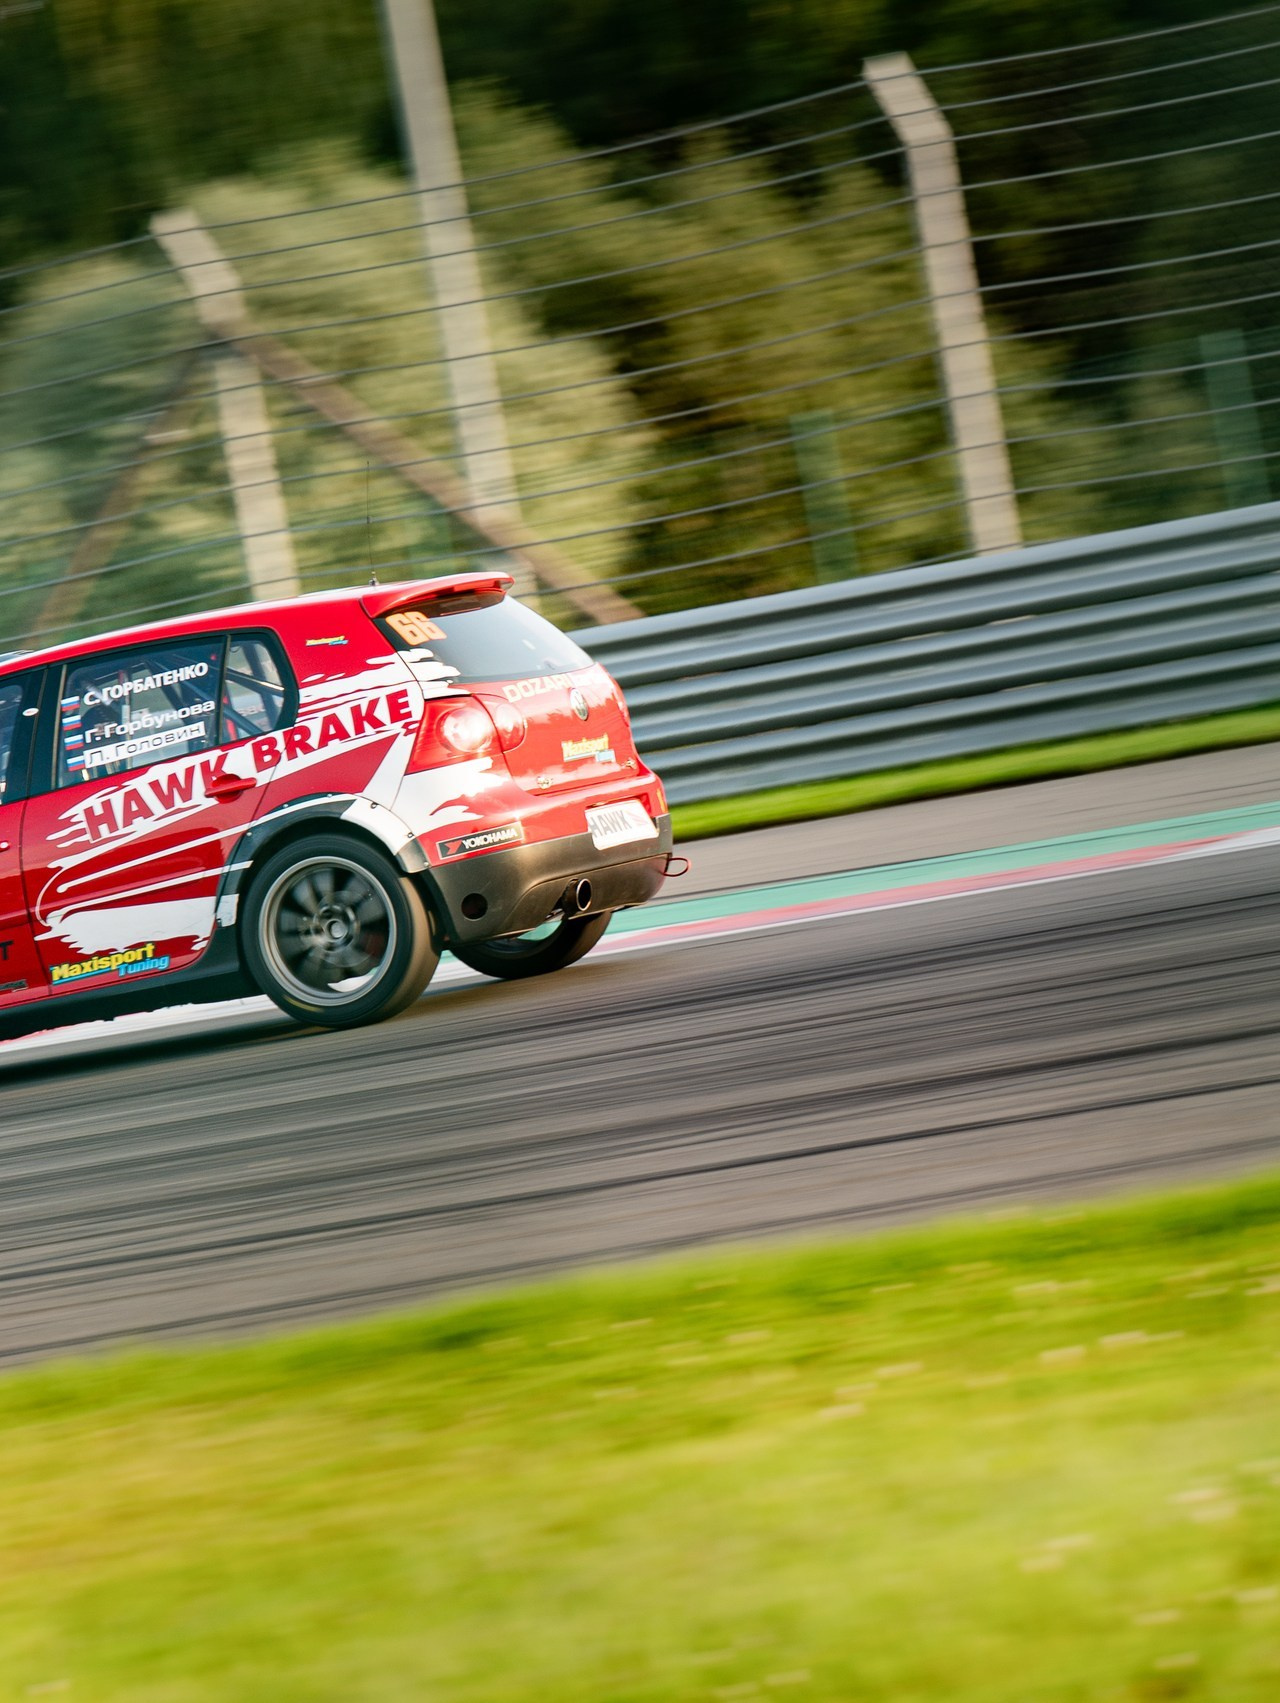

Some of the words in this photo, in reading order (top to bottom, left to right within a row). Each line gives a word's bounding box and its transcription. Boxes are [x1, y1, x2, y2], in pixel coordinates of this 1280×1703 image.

[385, 611, 447, 646] 66
[115, 726, 202, 757] Головин
[82, 751, 230, 843] HAWK
[251, 688, 414, 774] BRAKE
[461, 827, 518, 850] YOKOHAMA
[52, 943, 156, 982] Maxisport
[118, 955, 170, 977] Tuning
